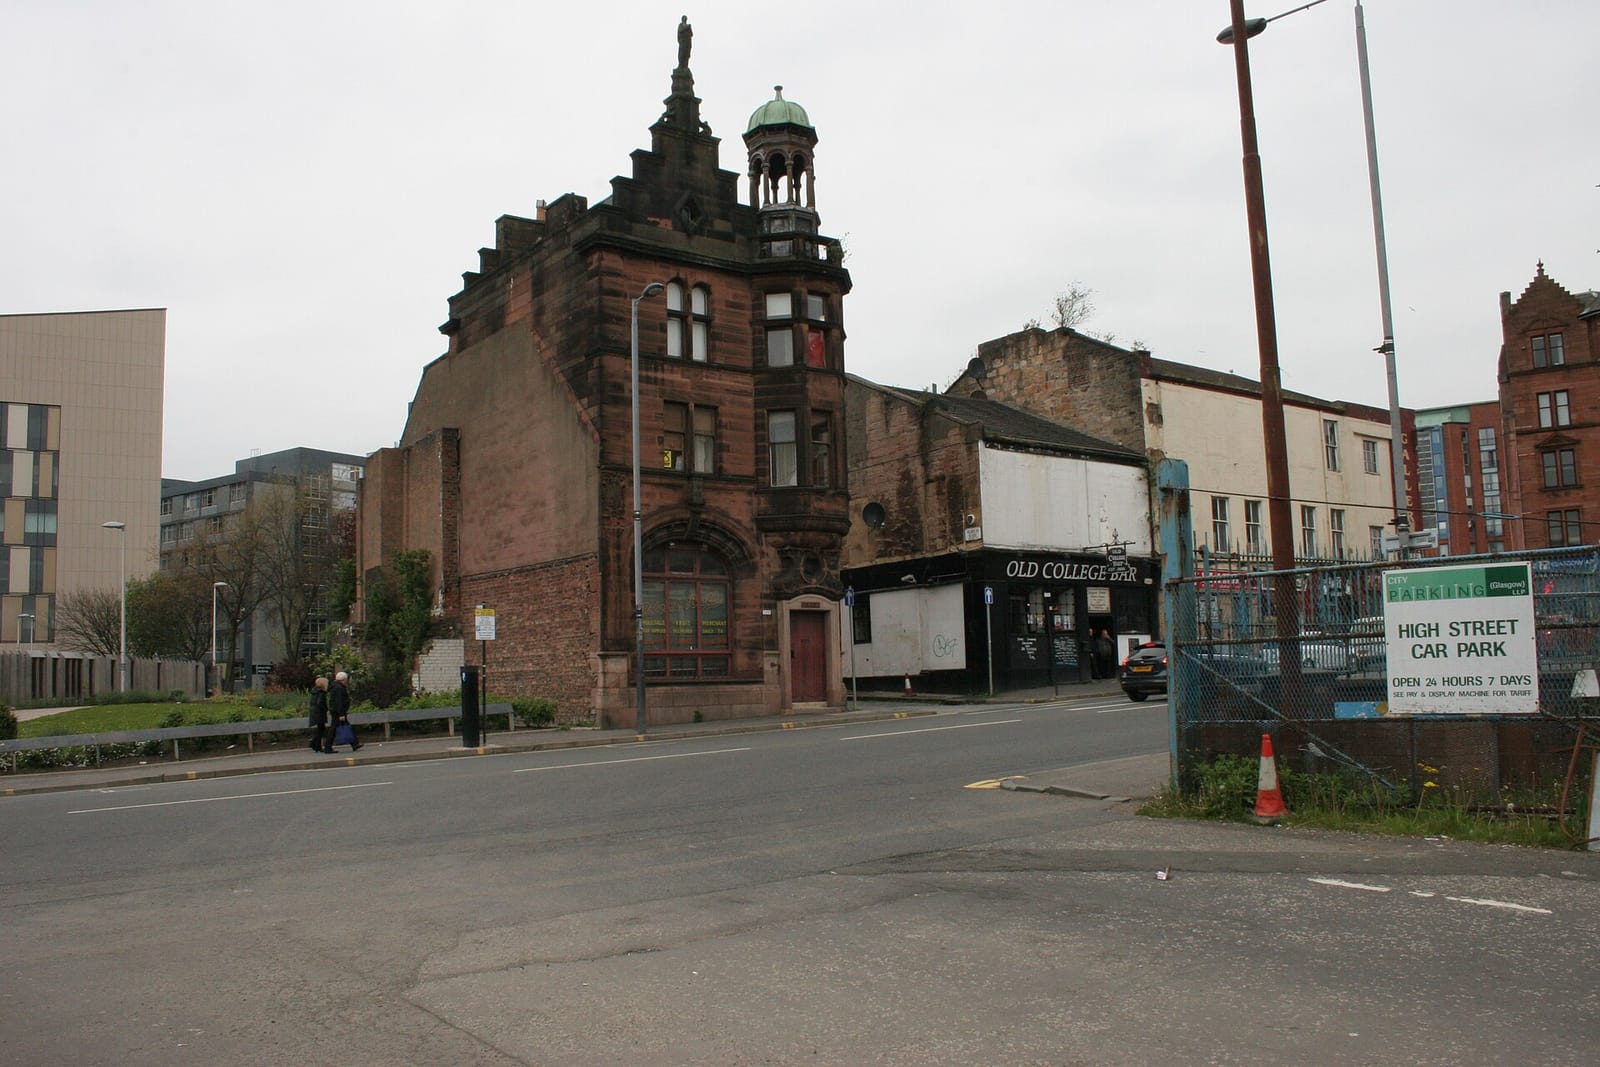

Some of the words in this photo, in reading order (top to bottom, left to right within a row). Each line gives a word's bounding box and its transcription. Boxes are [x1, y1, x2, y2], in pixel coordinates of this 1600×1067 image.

[1006, 561, 1039, 578] OLD
[1042, 562, 1107, 581] COLLEGE
[1109, 567, 1137, 582] BAR
[1387, 576, 1409, 585] CITY
[1490, 581, 1526, 590] (Glasgow)
[1389, 584, 1485, 601] PARKING
[1398, 622, 1440, 639] HIGH
[1448, 619, 1519, 637] STREET
[1411, 643, 1448, 660] CAR
[1457, 641, 1507, 658] PARK
[1392, 677, 1420, 687] OPEN
[1425, 678, 1437, 687] 24
[1442, 676, 1483, 687] HOURS
[1488, 677, 1495, 686] 7
[1500, 675, 1532, 686] DAYS
[1510, 689, 1533, 697] TARIFF
